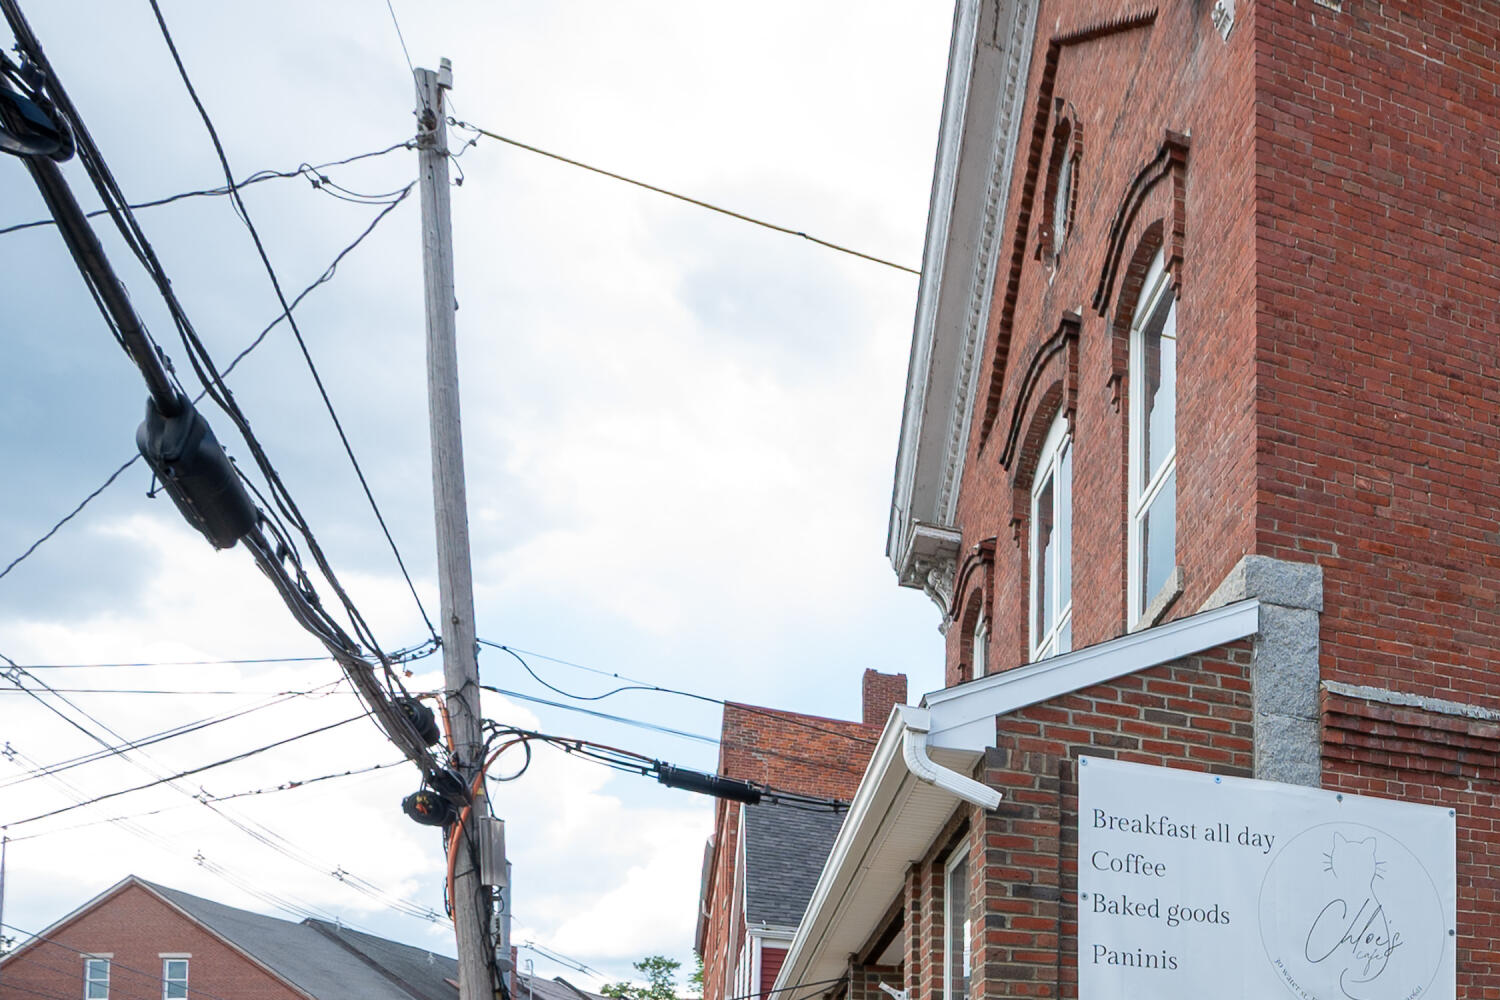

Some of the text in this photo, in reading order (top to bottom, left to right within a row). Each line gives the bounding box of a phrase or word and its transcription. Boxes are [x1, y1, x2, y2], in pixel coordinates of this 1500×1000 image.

[1092, 808, 1276, 855] Breakfast all day
[1091, 850, 1167, 878] Coffee
[1092, 892, 1231, 928] Baked goods
[1304, 897, 1404, 964] Chloe's
[1092, 943, 1179, 971] Paninis
